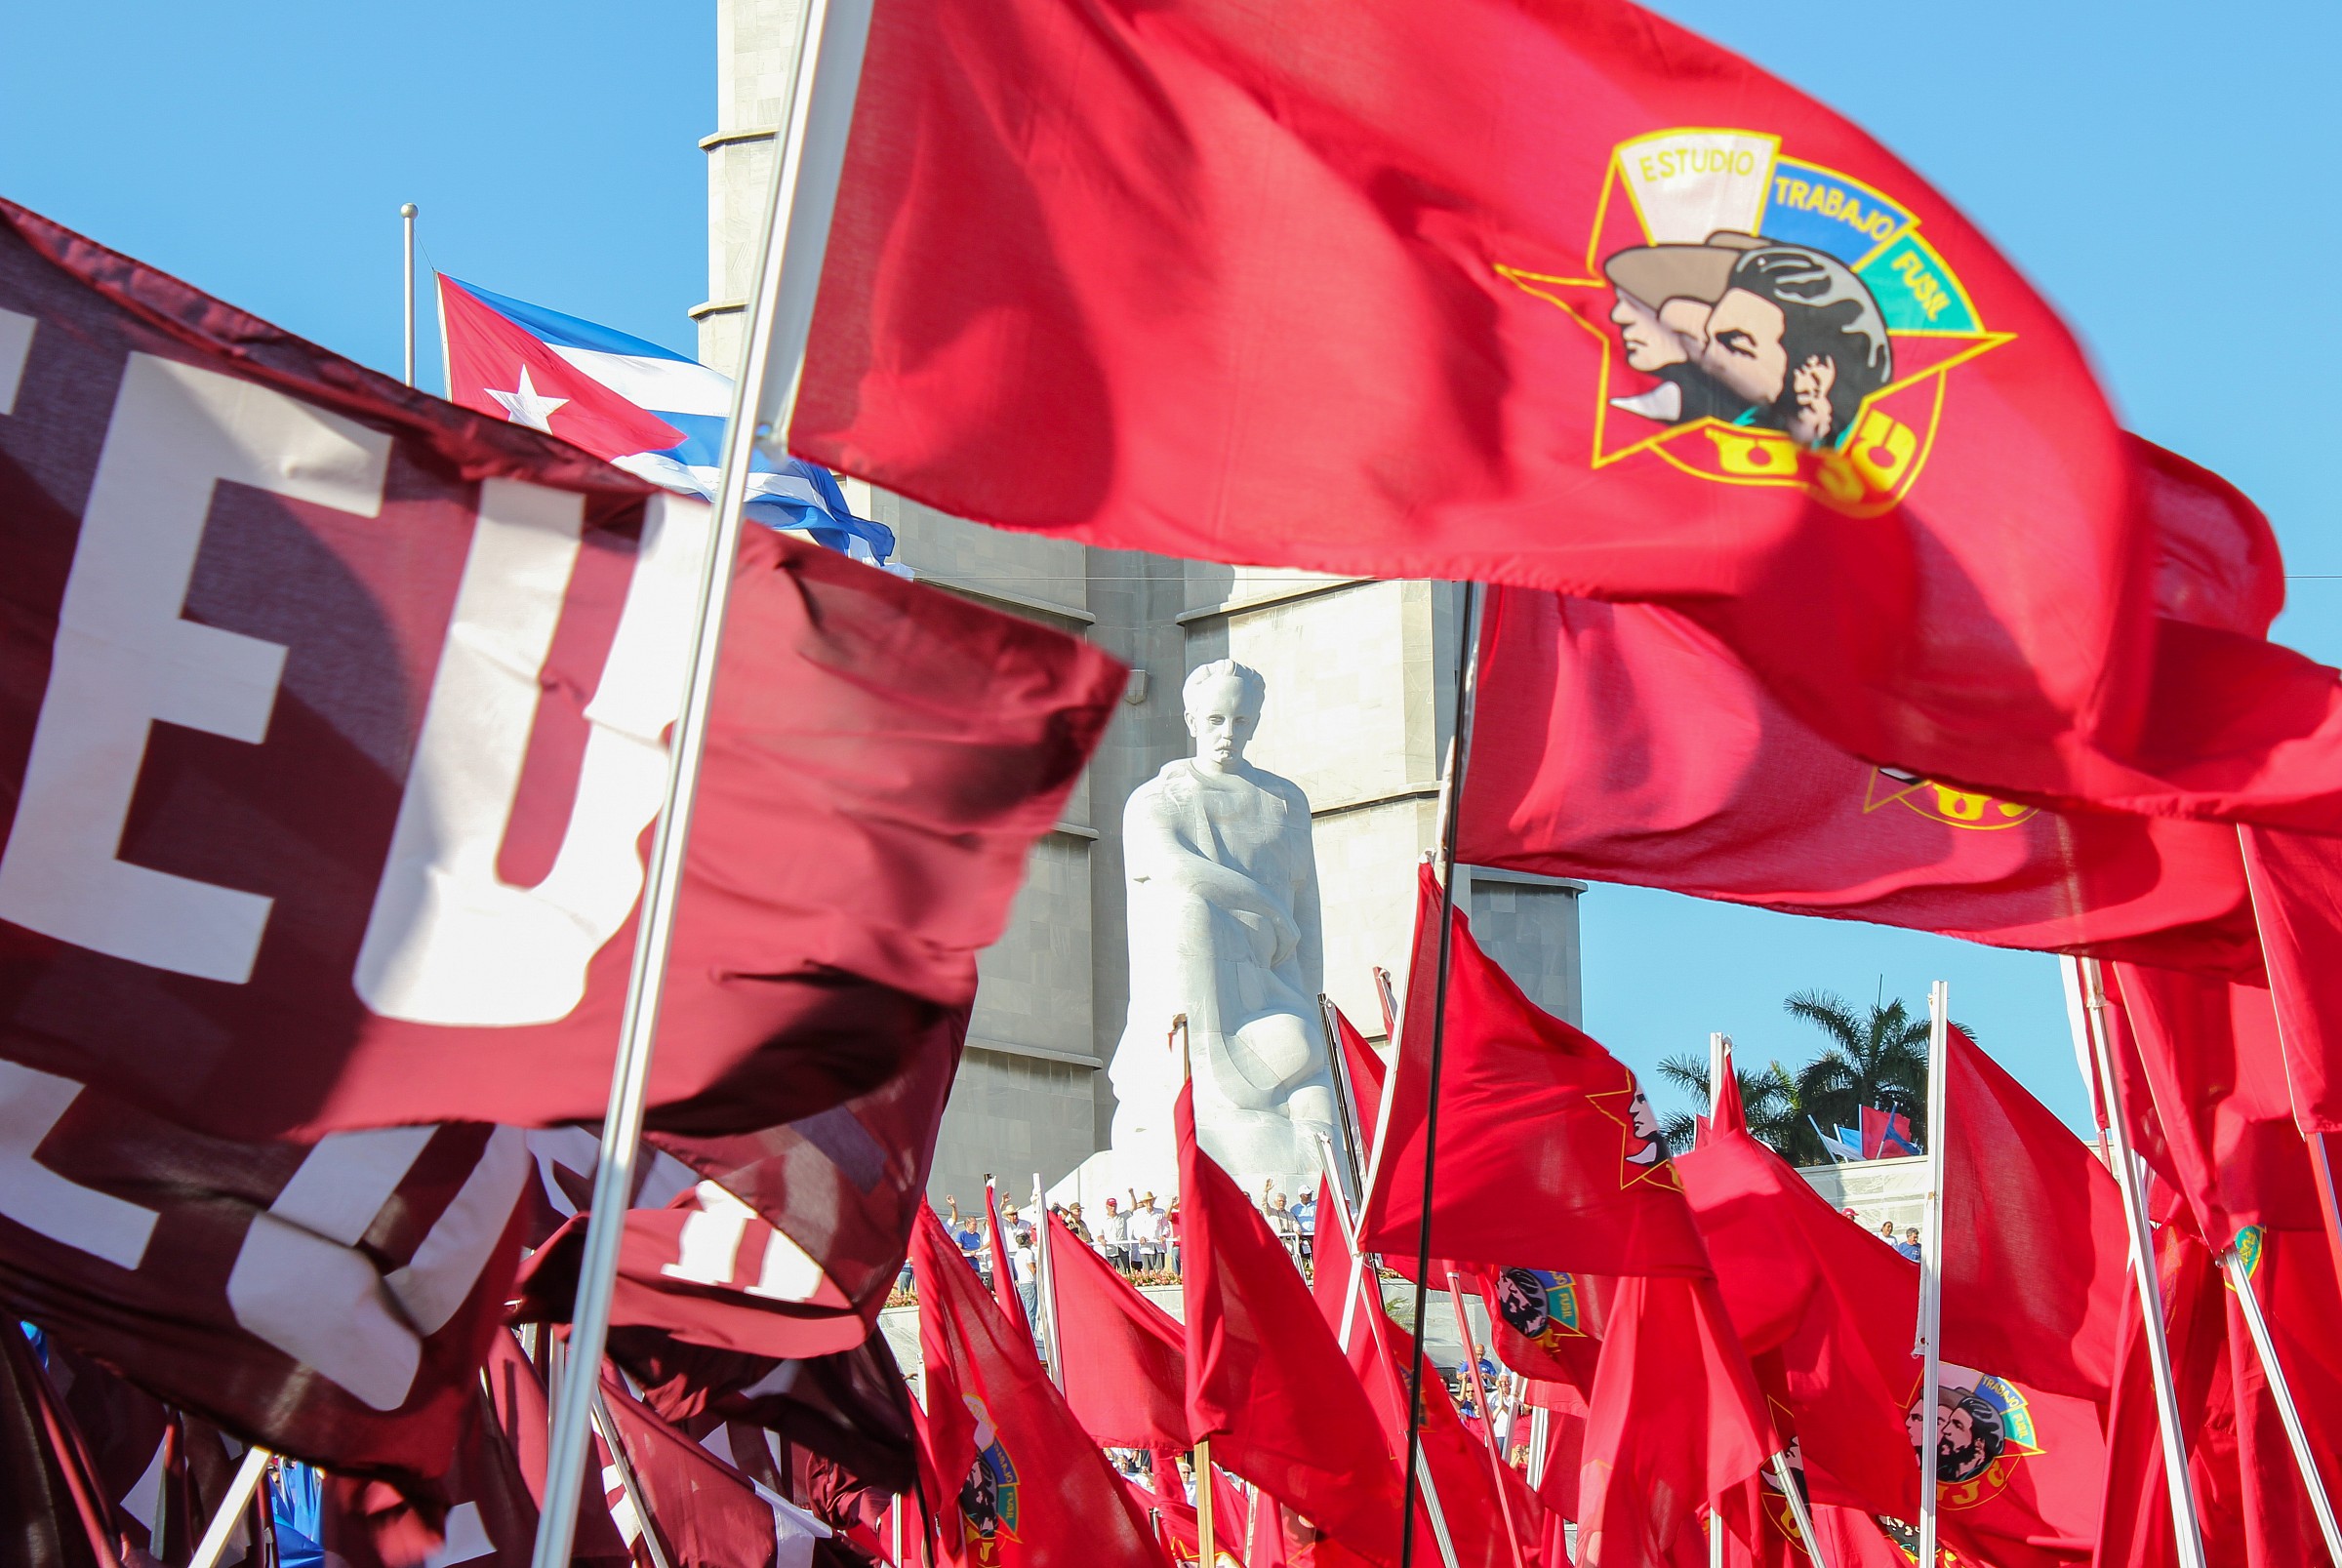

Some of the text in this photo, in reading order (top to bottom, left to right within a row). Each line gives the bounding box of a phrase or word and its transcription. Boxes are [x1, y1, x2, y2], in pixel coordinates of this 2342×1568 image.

[1638, 149, 1755, 182] ESTUDIO
[1775, 177, 1895, 242] TRABAJO
[1890, 250, 1951, 321] FUSIL
[0, 307, 714, 1027] EU
